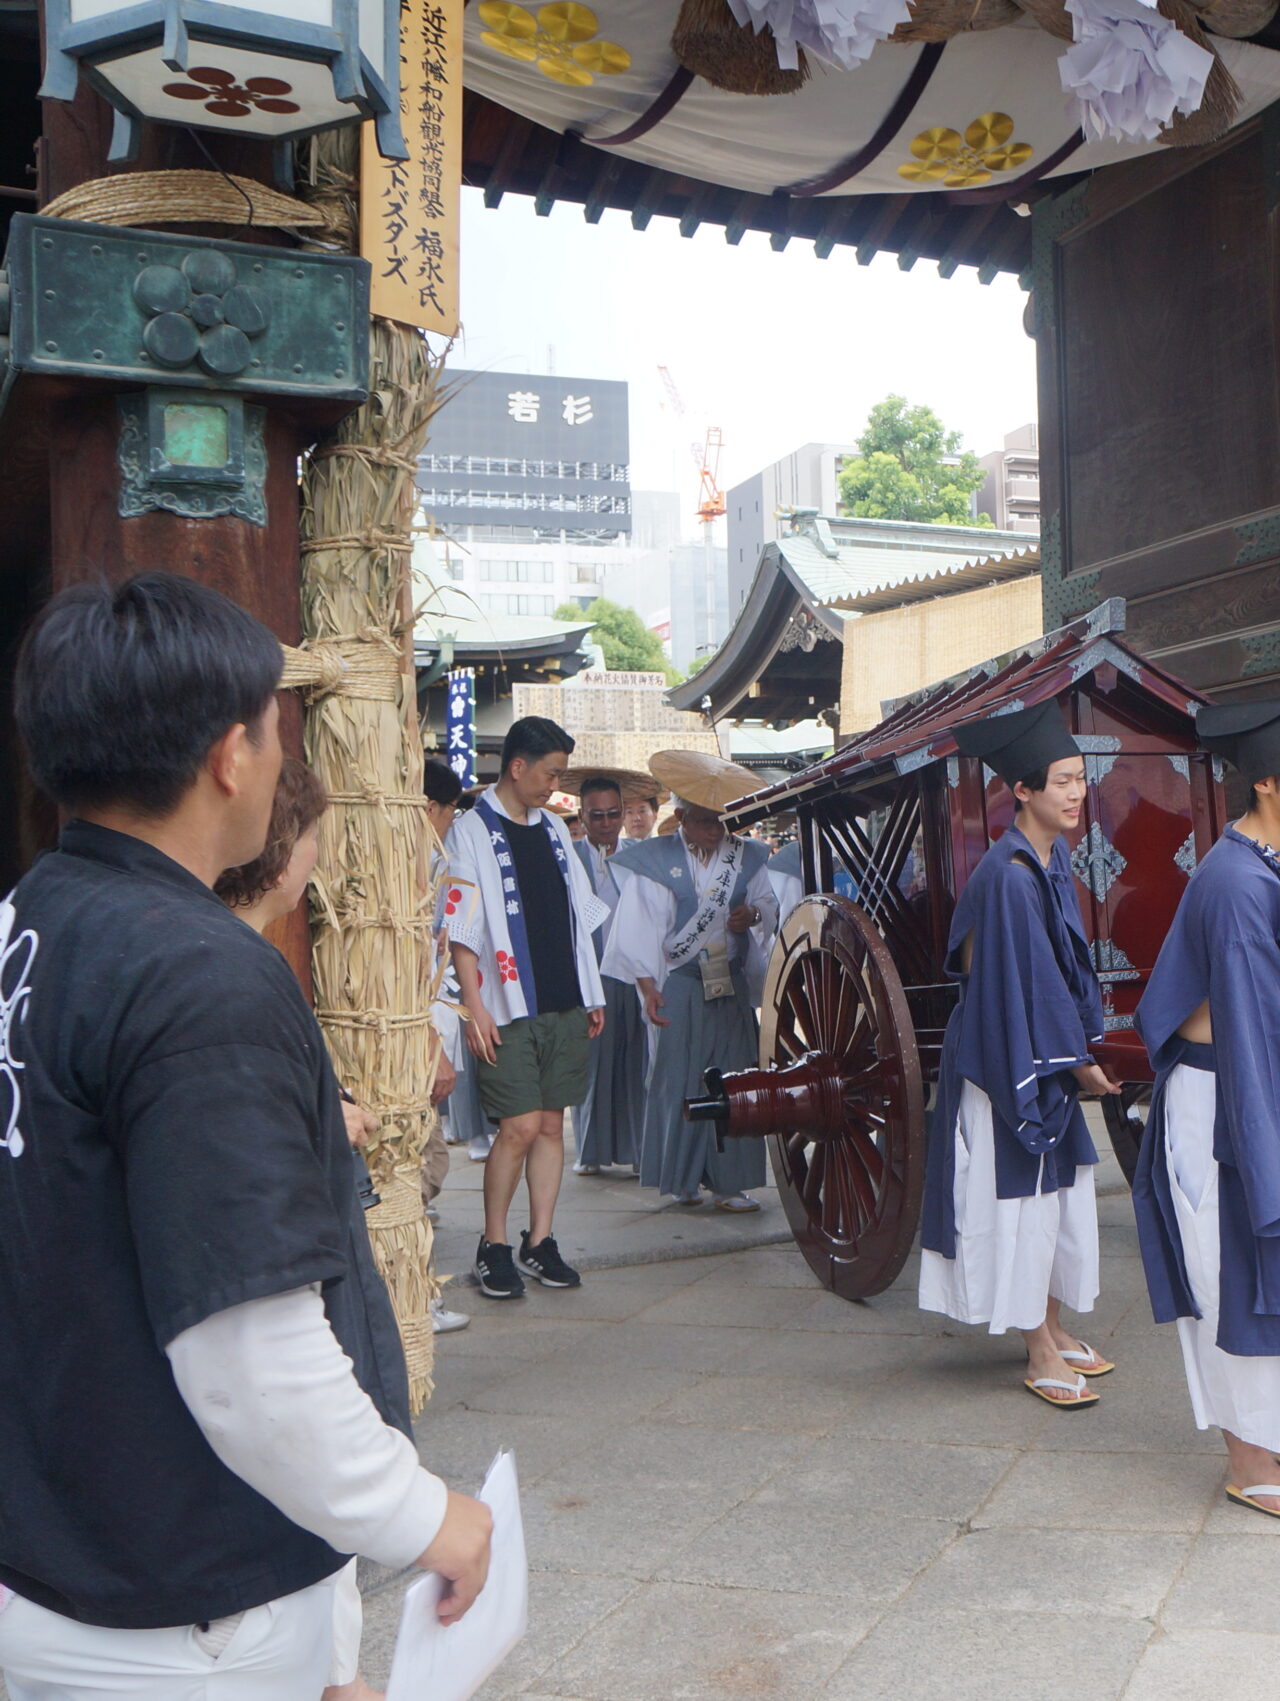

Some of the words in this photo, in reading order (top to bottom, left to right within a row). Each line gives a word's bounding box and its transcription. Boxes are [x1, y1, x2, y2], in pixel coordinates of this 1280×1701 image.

[418, 1, 449, 220] 近江八幡和船観光協同組合
[381, 140, 409, 285] ストバスターズ
[411, 227, 445, 316] 福永氏
[508, 391, 593, 425] 若杉
